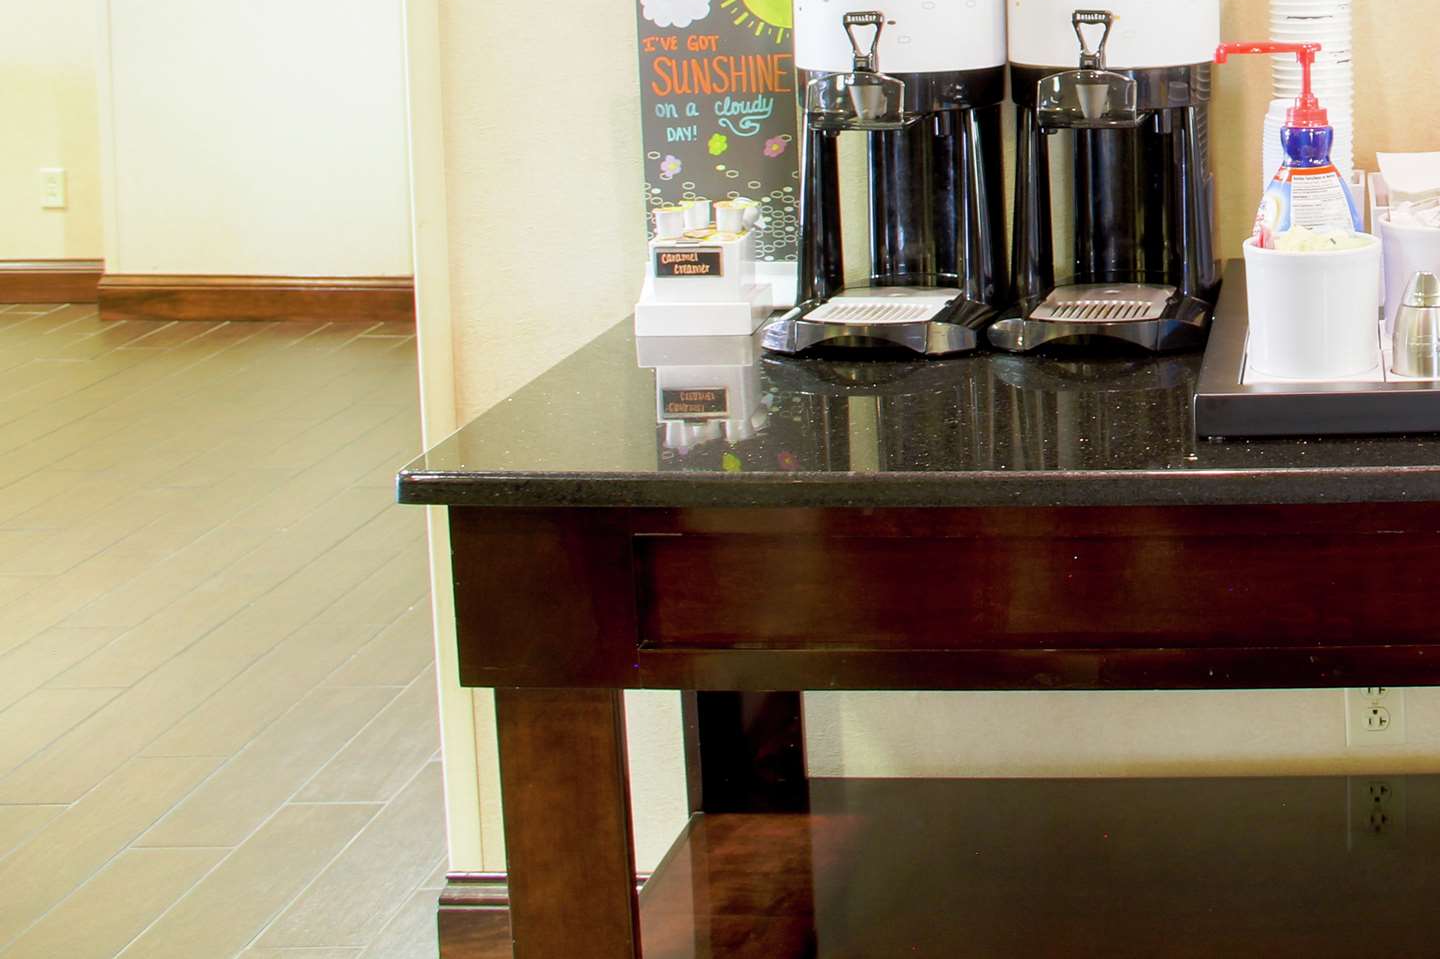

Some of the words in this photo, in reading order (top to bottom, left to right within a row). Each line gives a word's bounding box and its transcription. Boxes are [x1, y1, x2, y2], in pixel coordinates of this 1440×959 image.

[642, 35, 678, 52] I'VE
[687, 35, 720, 52] GOT
[651, 53, 793, 97] SUNSHINE
[655, 101, 678, 118] on
[686, 101, 700, 117] a
[714, 94, 774, 124] cloudy
[666, 125, 698, 142] DAY!
